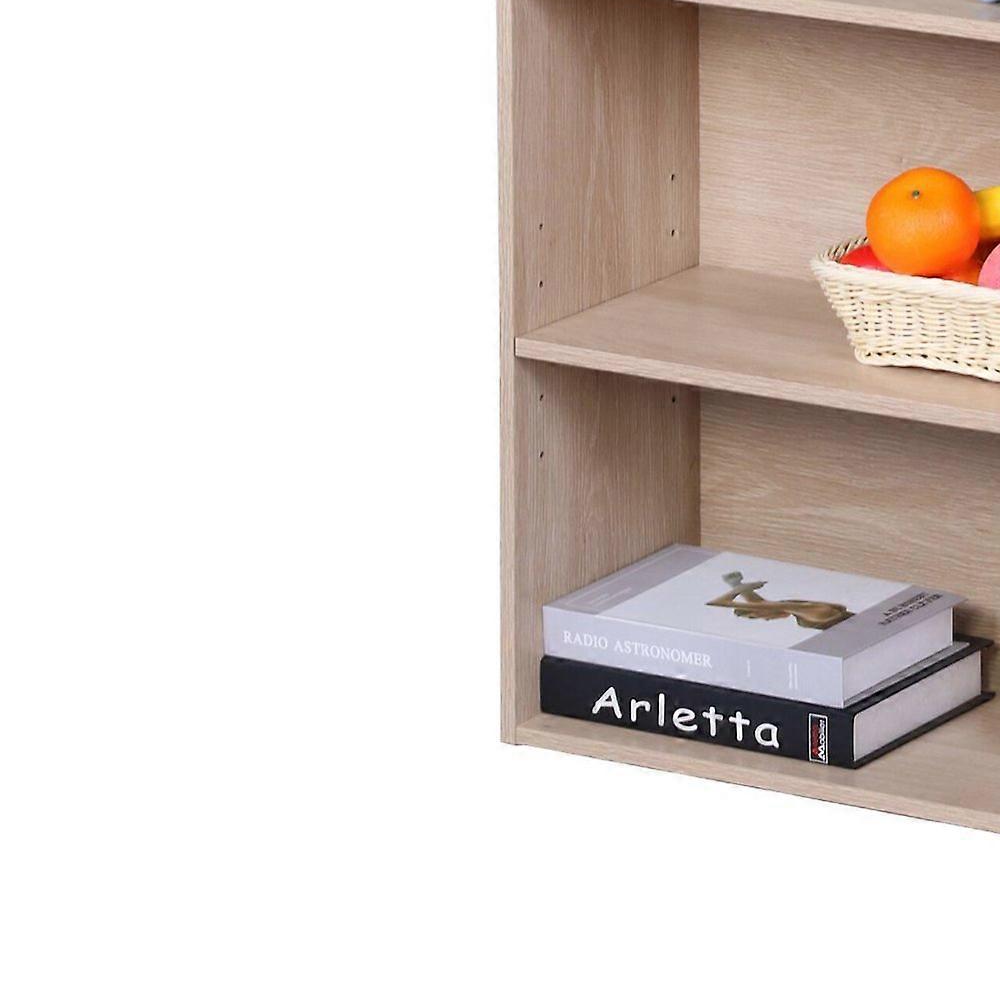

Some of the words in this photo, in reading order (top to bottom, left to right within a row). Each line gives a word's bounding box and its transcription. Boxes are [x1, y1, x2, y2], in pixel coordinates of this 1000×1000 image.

[563, 630, 608, 650] RADIO
[614, 640, 713, 669] ASTRONOMER
[591, 686, 781, 749] Arletta
